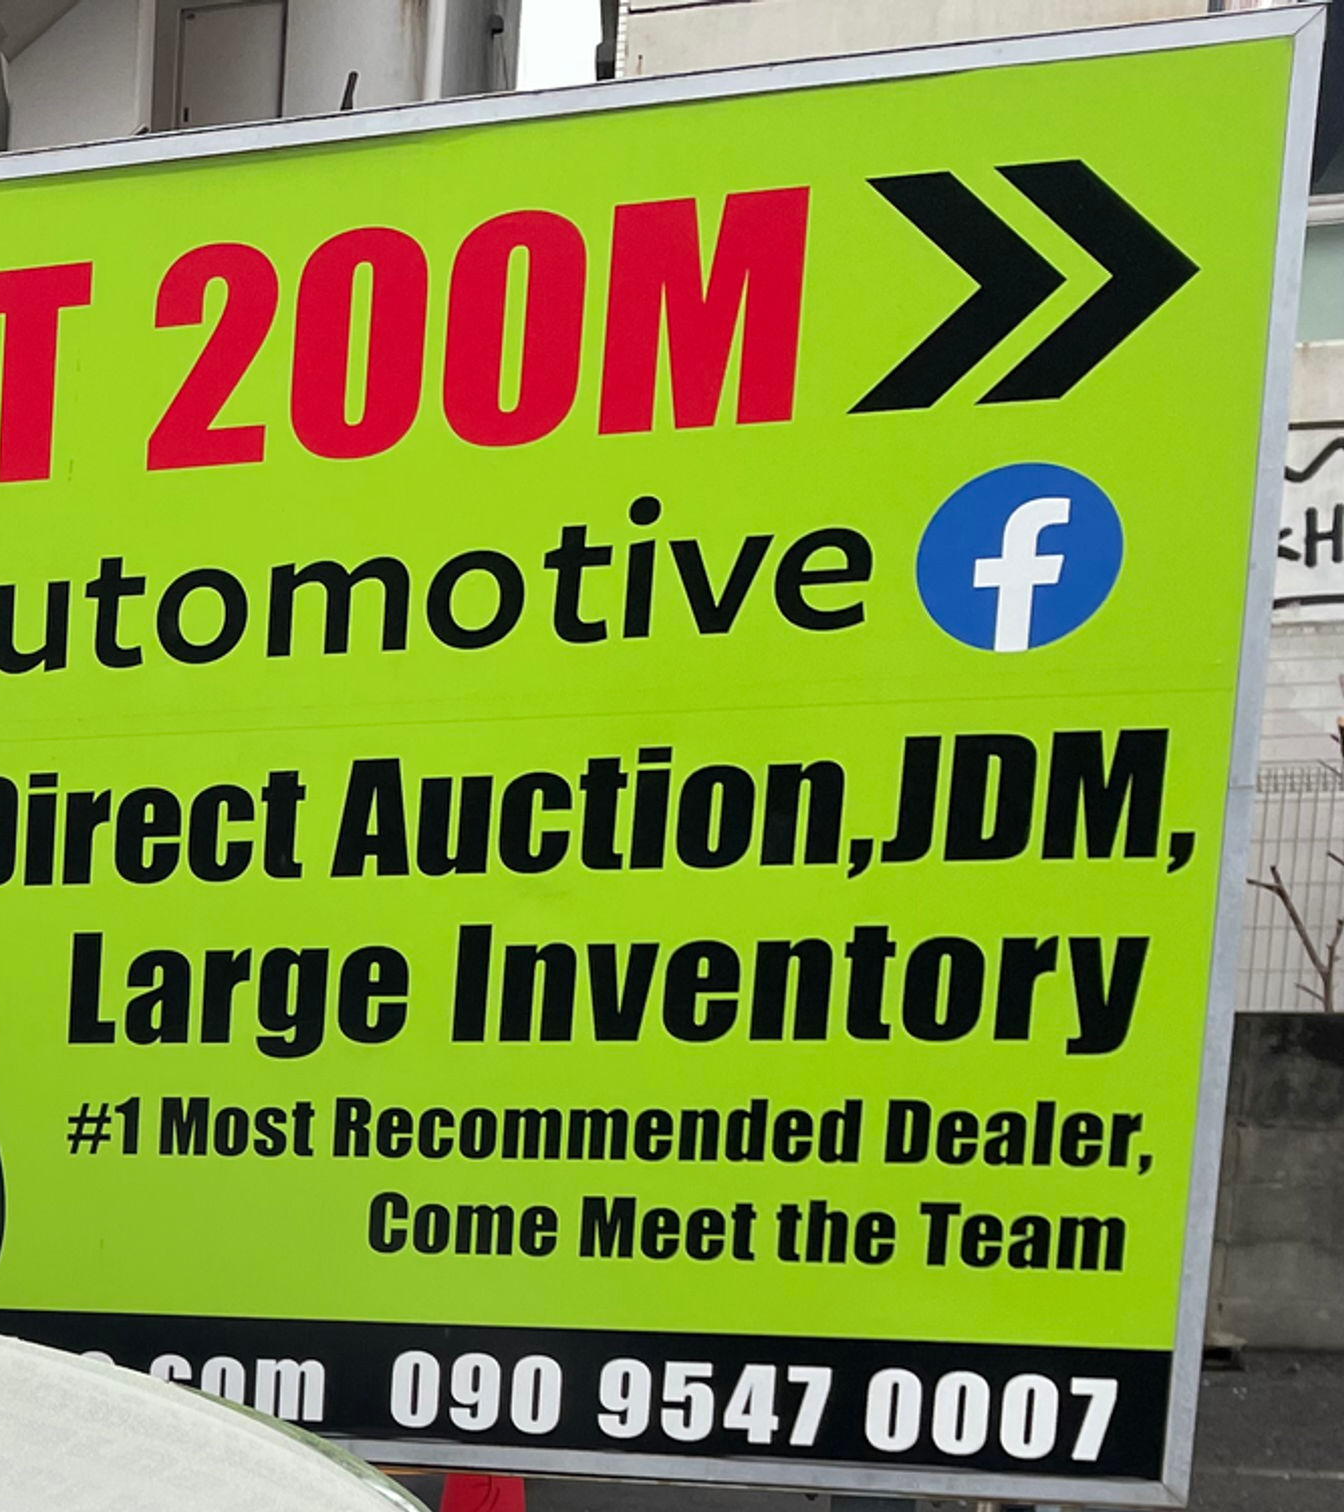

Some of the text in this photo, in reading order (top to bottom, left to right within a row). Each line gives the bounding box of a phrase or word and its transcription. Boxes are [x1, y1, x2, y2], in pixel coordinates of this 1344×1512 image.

[147, 187, 810, 470] 200M
[68, 925, 1150, 1059] Large Inventory
[68, 1097, 1153, 1176] #1 Most Recommended Dealer,
[369, 1192, 1126, 1272] Come Meet the Team
[391, 1350, 562, 1434] 090
[599, 1358, 832, 1446] 9547
[865, 1369, 1118, 1461] 0007
